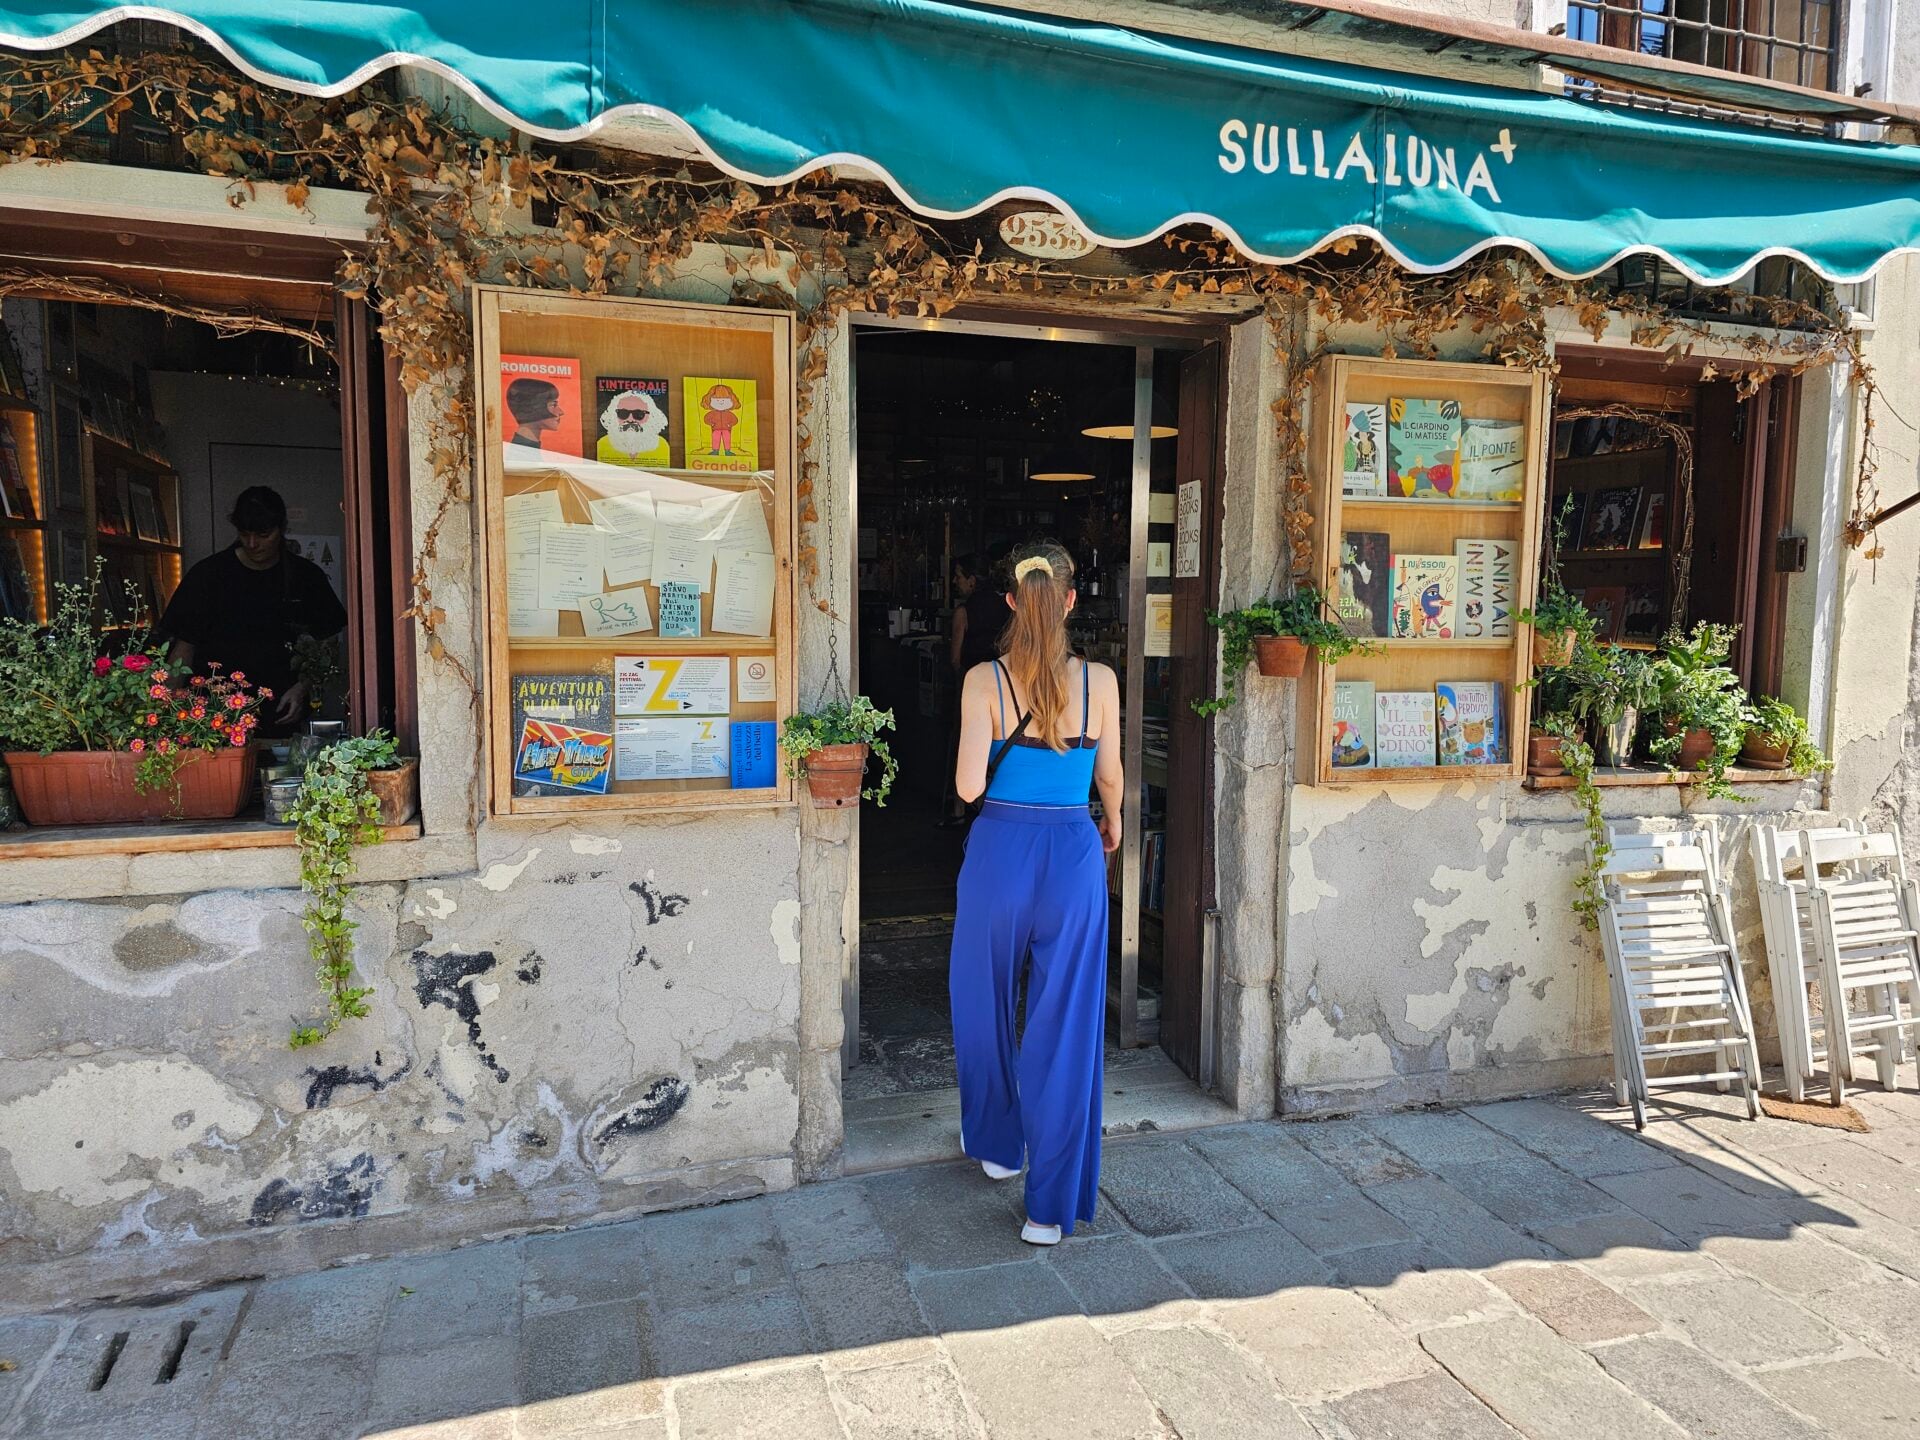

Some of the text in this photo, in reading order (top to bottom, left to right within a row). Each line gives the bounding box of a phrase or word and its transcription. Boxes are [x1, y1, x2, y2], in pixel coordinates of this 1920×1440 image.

[599, 380, 667, 392] L'INTEGRALE
[1403, 421, 1409, 430] IL
[1405, 431, 1447, 440] DI MATISSE
[1469, 441, 1517, 458] IL PONTE
[691, 459, 752, 472] Grande!
[1180, 487, 1193, 501] READ
[1179, 500, 1199, 516] BOOKS
[1178, 517, 1188, 530] BUY
[1178, 530, 1199, 545] BOOKS
[1177, 546, 1188, 559] BUY
[1177, 560, 1196, 574] LOCAL
[1492, 545, 1509, 638] ANIMALI
[519, 681, 604, 698] AVVENTURA
[1334, 691, 1353, 704] HE
[523, 697, 601, 713] DI UN TOPO
[1458, 702, 1489, 715] PERDUTO
[560, 712, 566, 723] A
[1387, 709, 1403, 722] IL
[1391, 724, 1429, 737] GIAR
[1386, 739, 1426, 752] DINO
